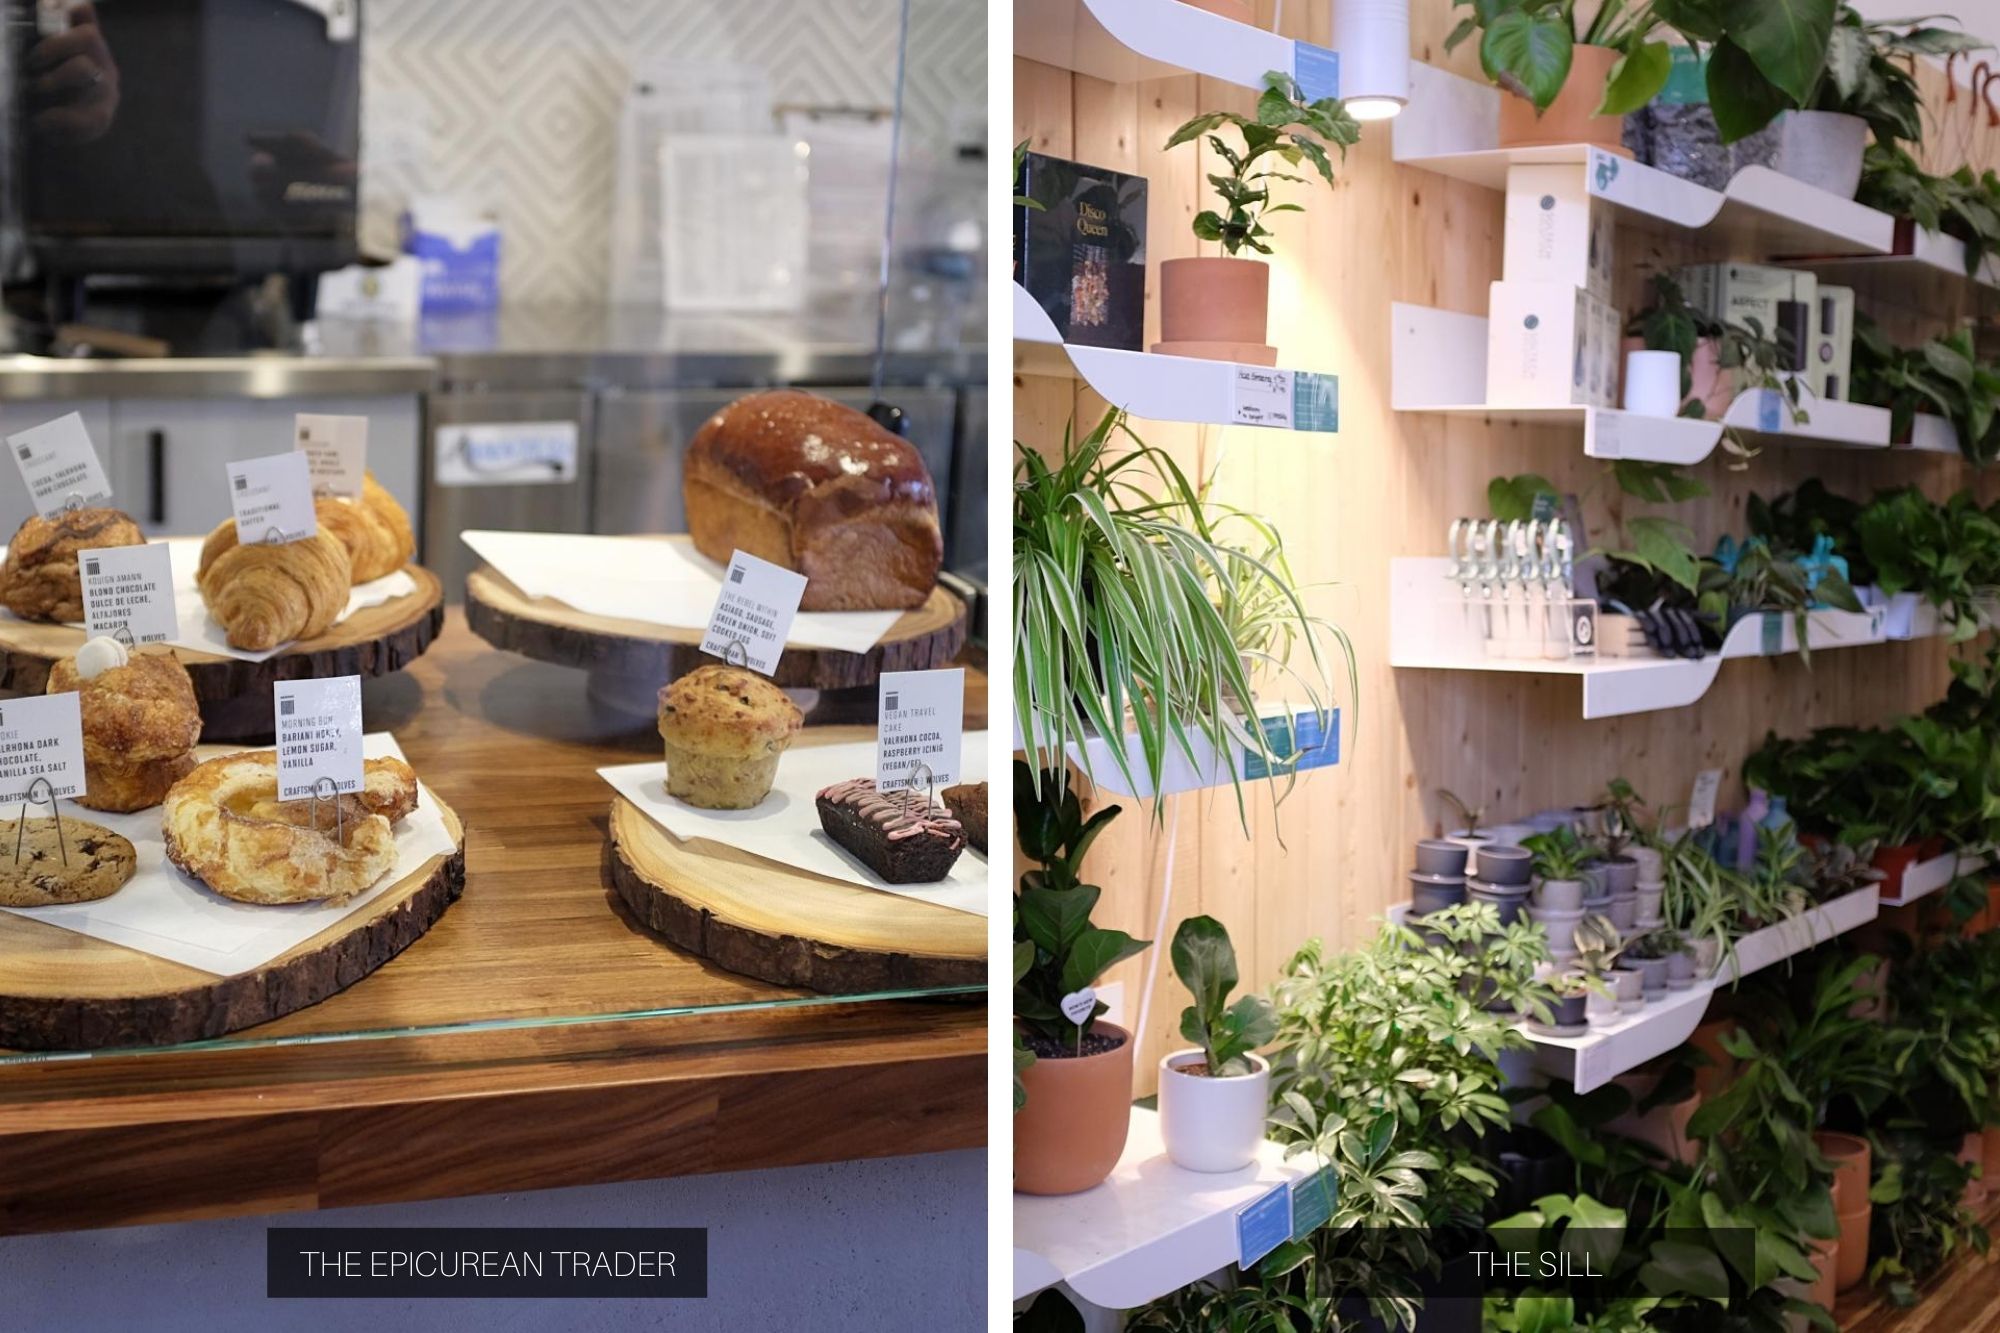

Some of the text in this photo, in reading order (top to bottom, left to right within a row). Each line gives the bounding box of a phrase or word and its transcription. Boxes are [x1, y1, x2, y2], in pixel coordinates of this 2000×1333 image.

[1080, 201, 1106, 220] Disco
[1077, 217, 1108, 237] Queen
[116, 573, 143, 583] AMANN
[89, 582, 156, 598] BLOND CHOCOLATE
[90, 595, 152, 609] DULCE DE LECHE,
[92, 608, 132, 620] ALFAJORES
[720, 602, 775, 630] ASIAGO, SAUSAGE,
[93, 620, 128, 630] MACARON
[716, 613, 777, 642] GREEN ONION, SOFT
[141, 633, 167, 643] WOLVES
[712, 624, 752, 645] COOKED EGG
[884, 707, 936, 721] VEGAN TRAVEL
[281, 717, 317, 729] MORNING
[883, 723, 902, 733] CAKE
[0, 730, 19, 741] OKIE
[883, 731, 942, 746] VALRHONA COCOA,
[0, 738, 60, 754] LRHONA DARK
[282, 742, 337, 756] LEMON SUGAR,
[883, 747, 921, 758] RASPBERRY
[30, 765, 45, 775] SEA
[47, 761, 67, 772] SALT
[282, 757, 314, 769] VANILLA
